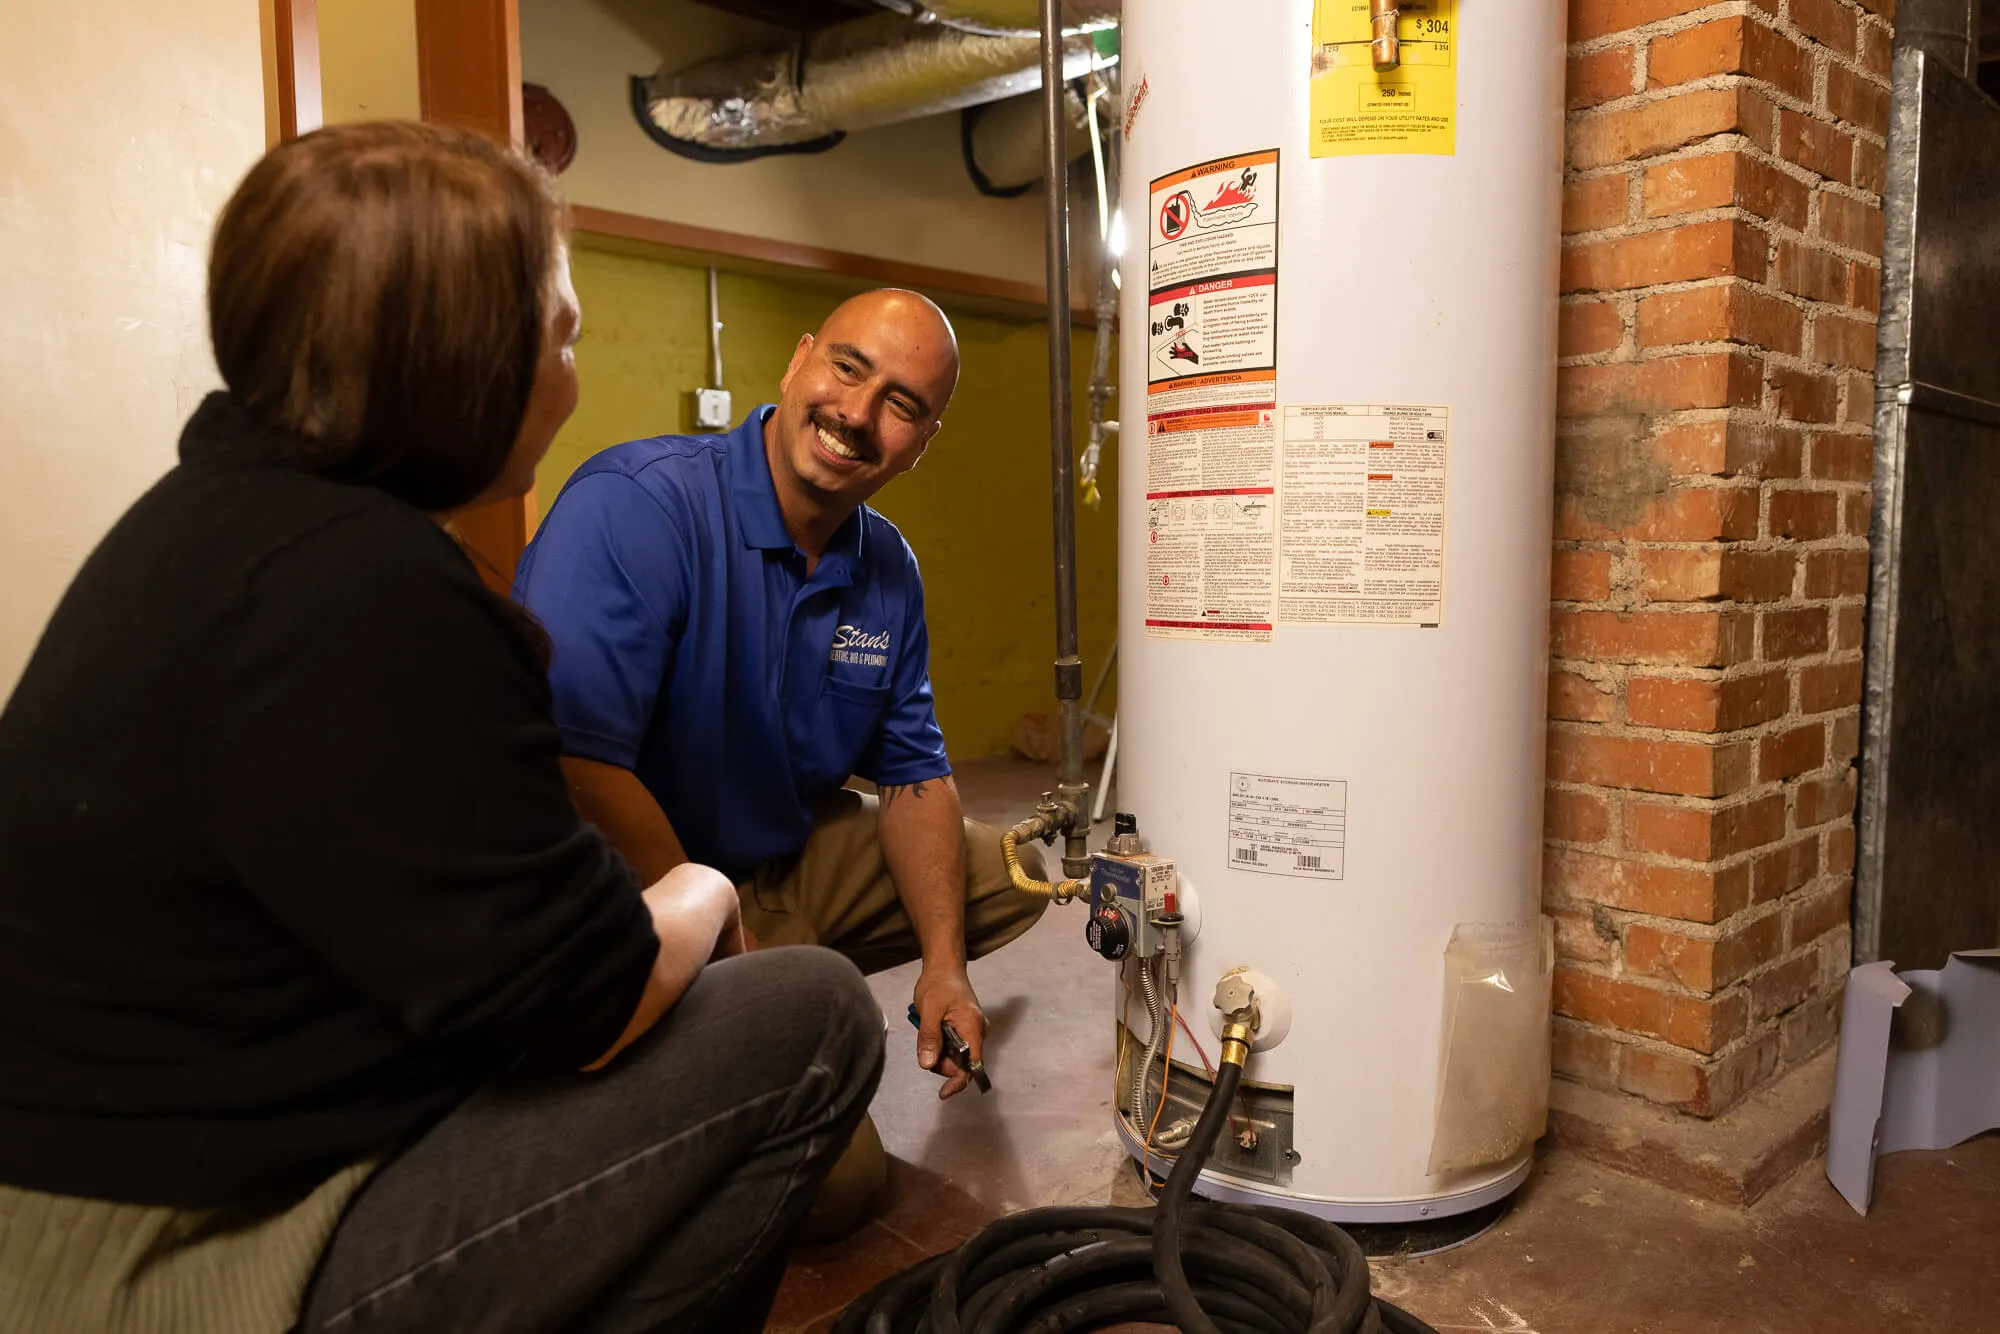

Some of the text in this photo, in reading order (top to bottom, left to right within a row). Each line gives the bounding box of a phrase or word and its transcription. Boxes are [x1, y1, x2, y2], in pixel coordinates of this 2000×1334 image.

[1416, 18, 1449, 33] $ 304
[1382, 89, 1396, 97] 250
[1197, 160, 1235, 177] WARNING
[1198, 280, 1233, 293] DANGER
[1173, 379, 1196, 388] WARNING
[1200, 375, 1242, 385] ADVERTENCIA
[832, 624, 890, 650] Stan's
